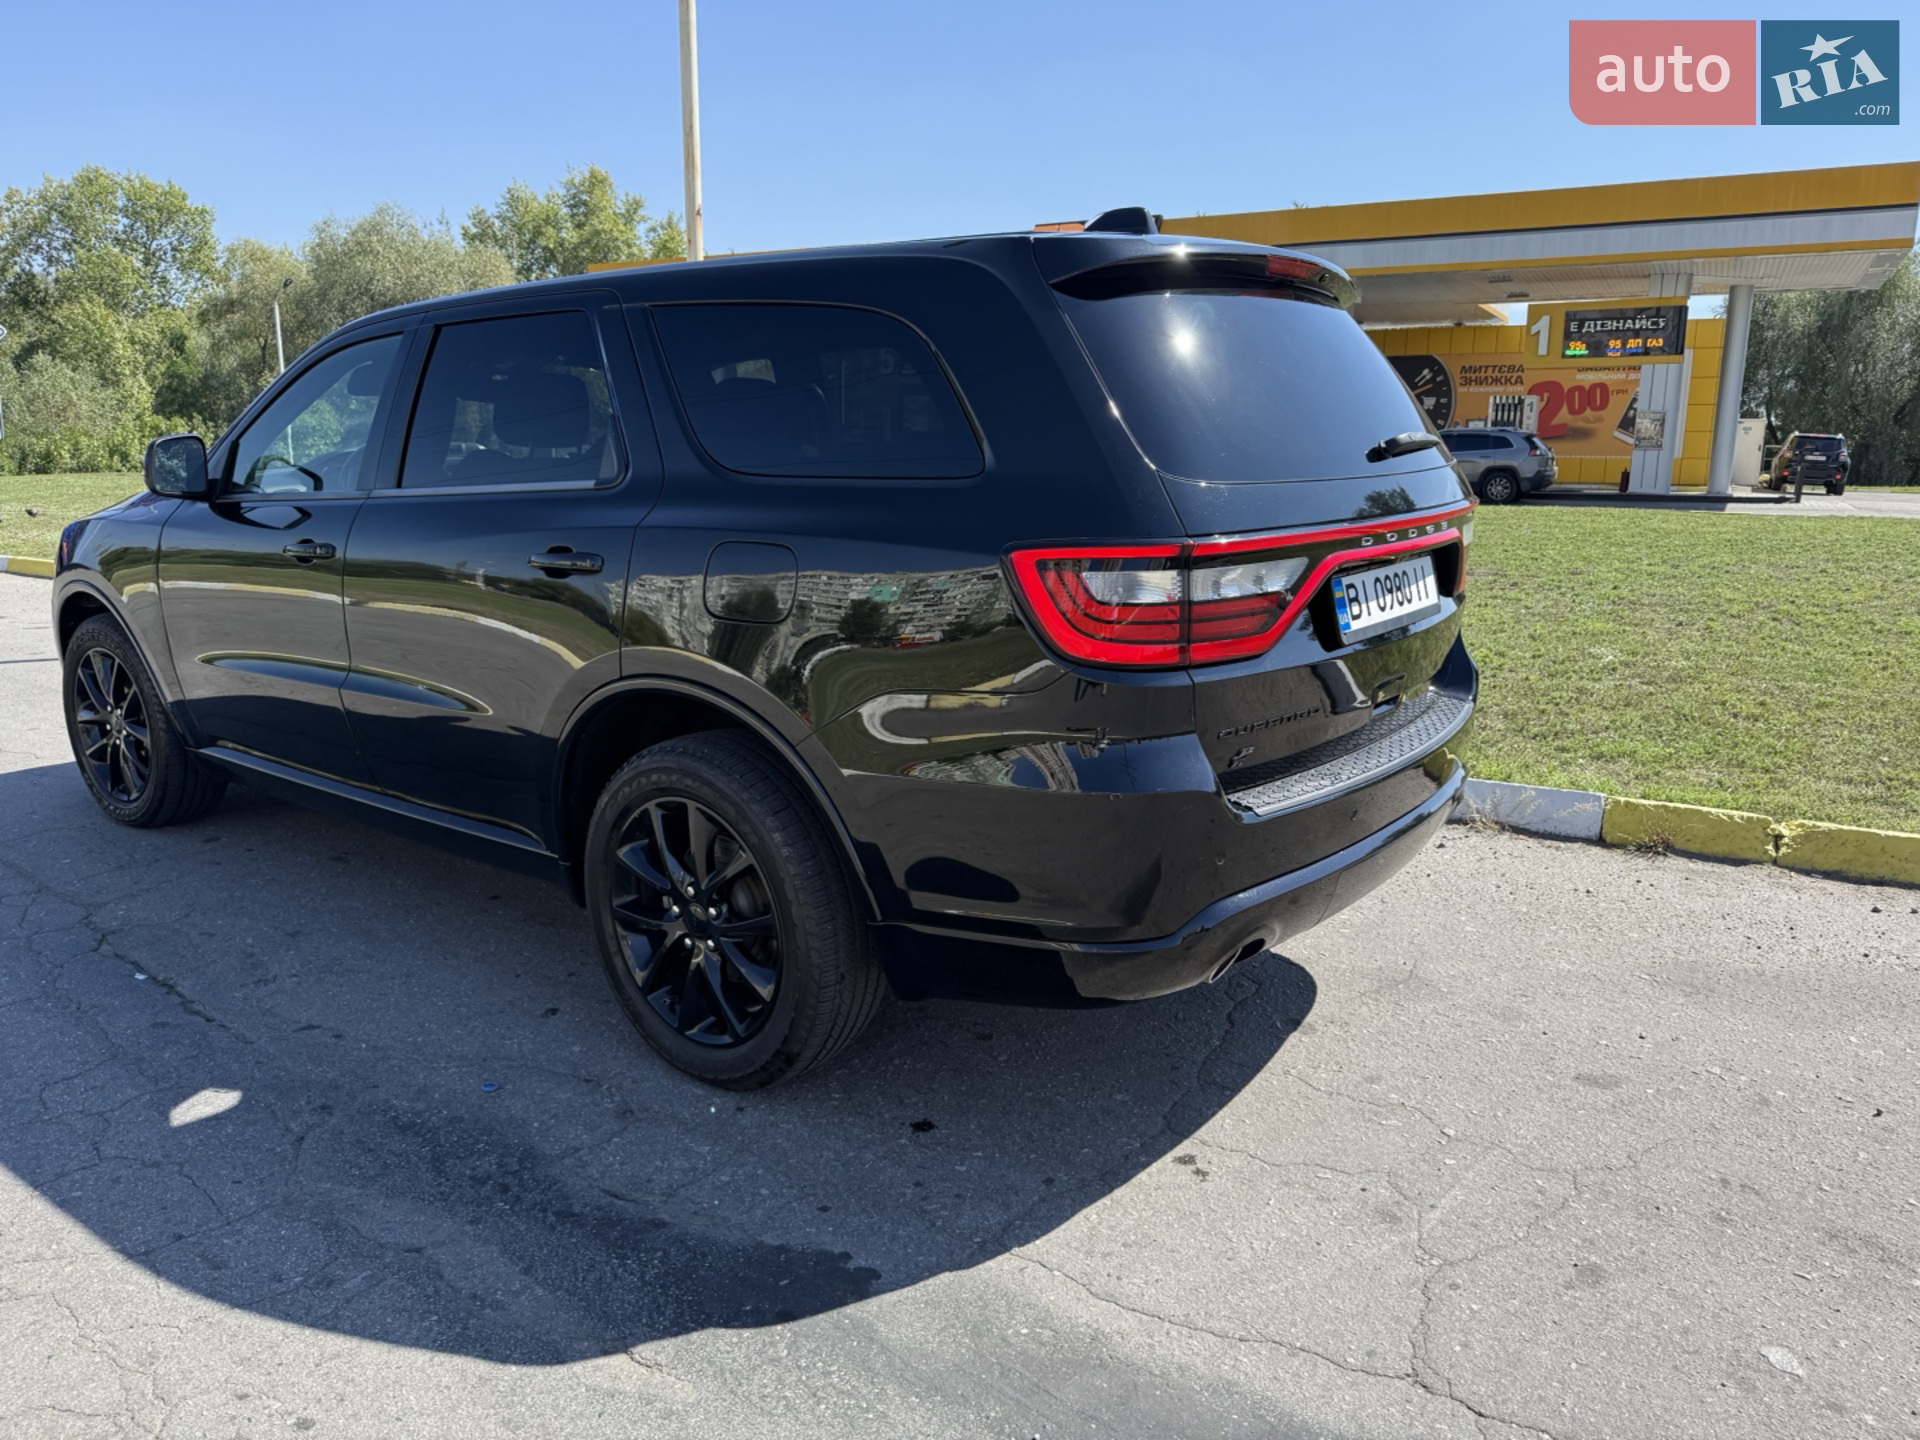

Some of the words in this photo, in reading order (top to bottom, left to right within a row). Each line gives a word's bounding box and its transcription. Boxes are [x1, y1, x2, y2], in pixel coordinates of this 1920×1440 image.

[1530, 314, 1551, 356] 1
[1608, 339, 1622, 348] 95
[1625, 338, 1643, 349] ДП
[1646, 337, 1664, 347] ГАЗ
[1459, 363, 1525, 375] МИТТЄВА
[1458, 375, 1524, 386] ЗНИЖКА
[1360, 520, 1449, 547] DODGE
[1345, 579, 1371, 621] BI
[1374, 569, 1413, 613] 0980
